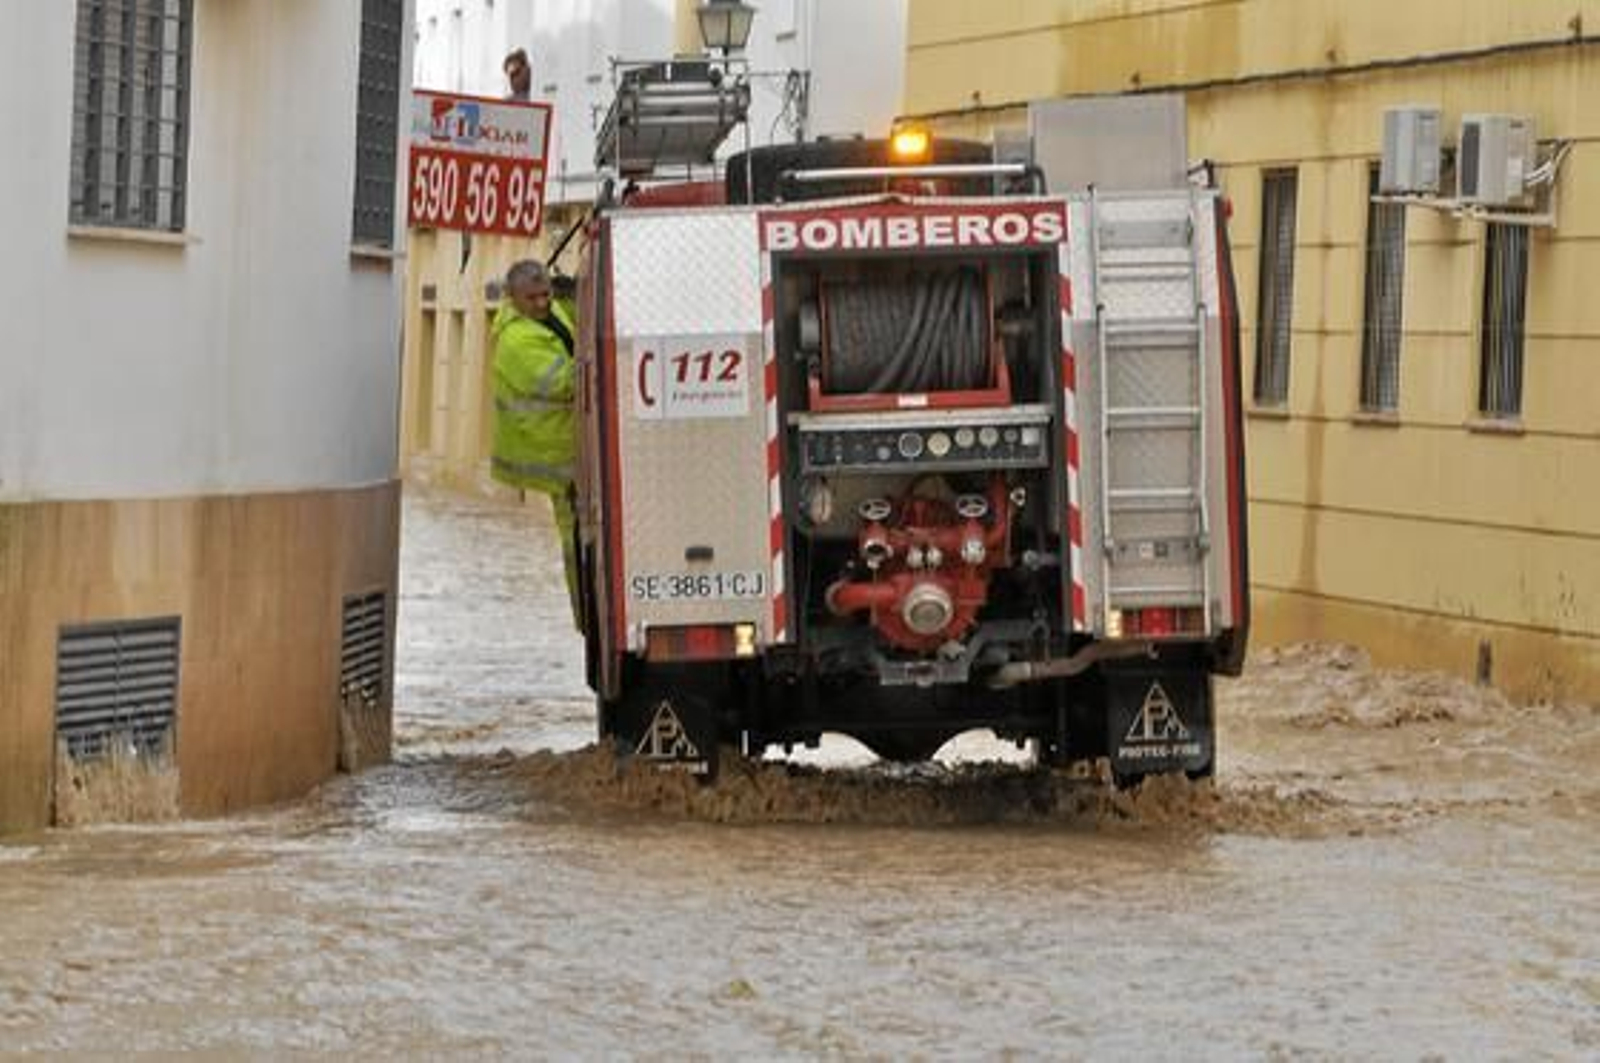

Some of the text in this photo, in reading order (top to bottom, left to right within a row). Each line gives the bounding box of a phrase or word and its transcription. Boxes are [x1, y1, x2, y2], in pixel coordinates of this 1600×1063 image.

[412, 155, 543, 232] 590 56 95
[765, 211, 1063, 250] BOMBEROS
[671, 350, 742, 383] 112
